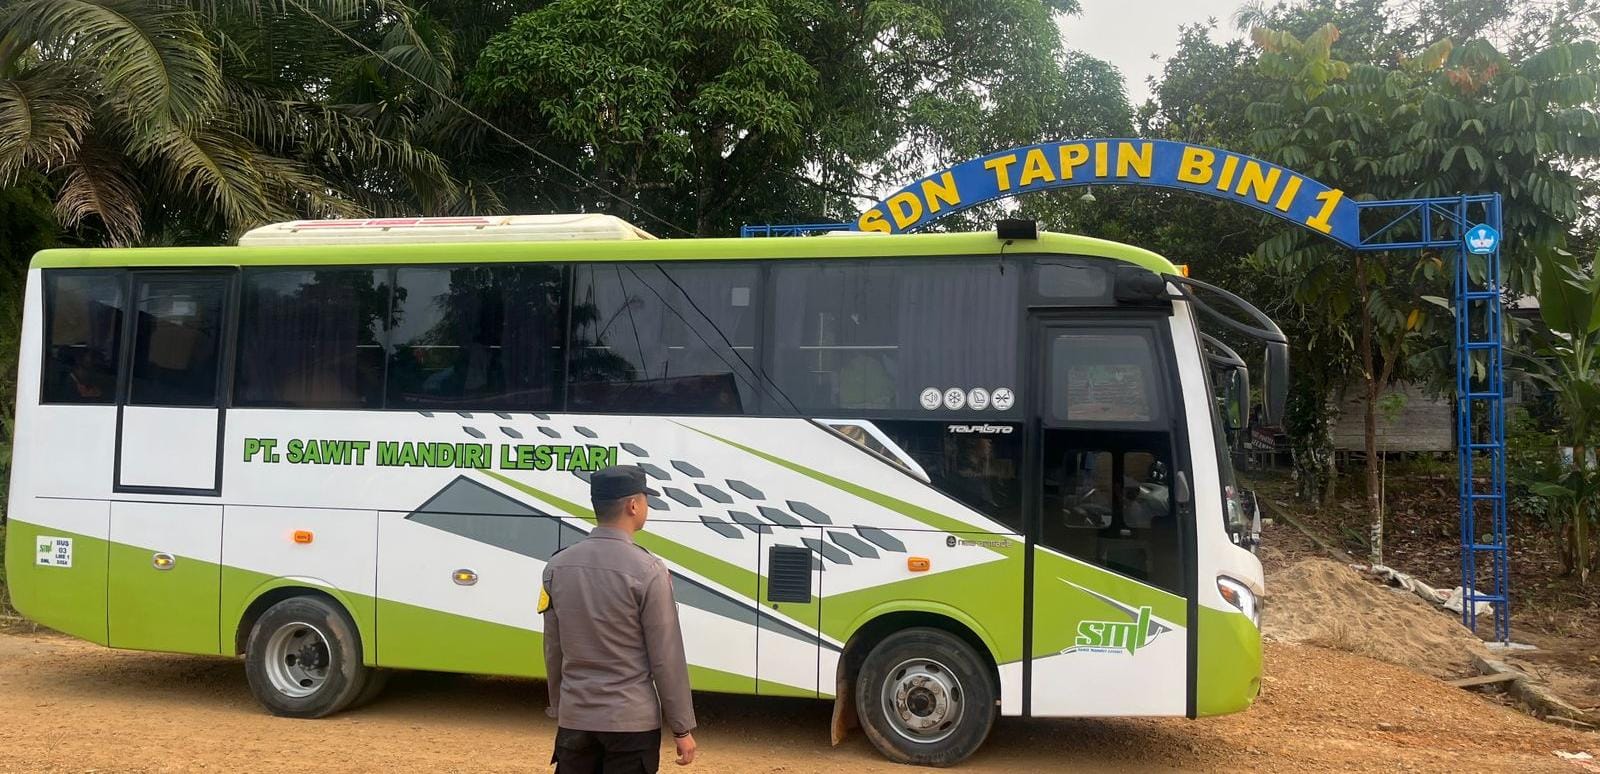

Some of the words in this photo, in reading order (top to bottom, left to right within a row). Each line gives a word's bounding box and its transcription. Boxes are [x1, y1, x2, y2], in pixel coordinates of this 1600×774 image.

[858, 172, 961, 234] SDN
[984, 142, 1153, 191] TAPIN
[1177, 146, 1304, 212] BINI
[1305, 188, 1345, 234] 1
[244, 438, 281, 463] PT.
[286, 439, 371, 465] SAWIT
[376, 441, 493, 468] MANDIRI
[500, 444, 618, 471] LESTARI
